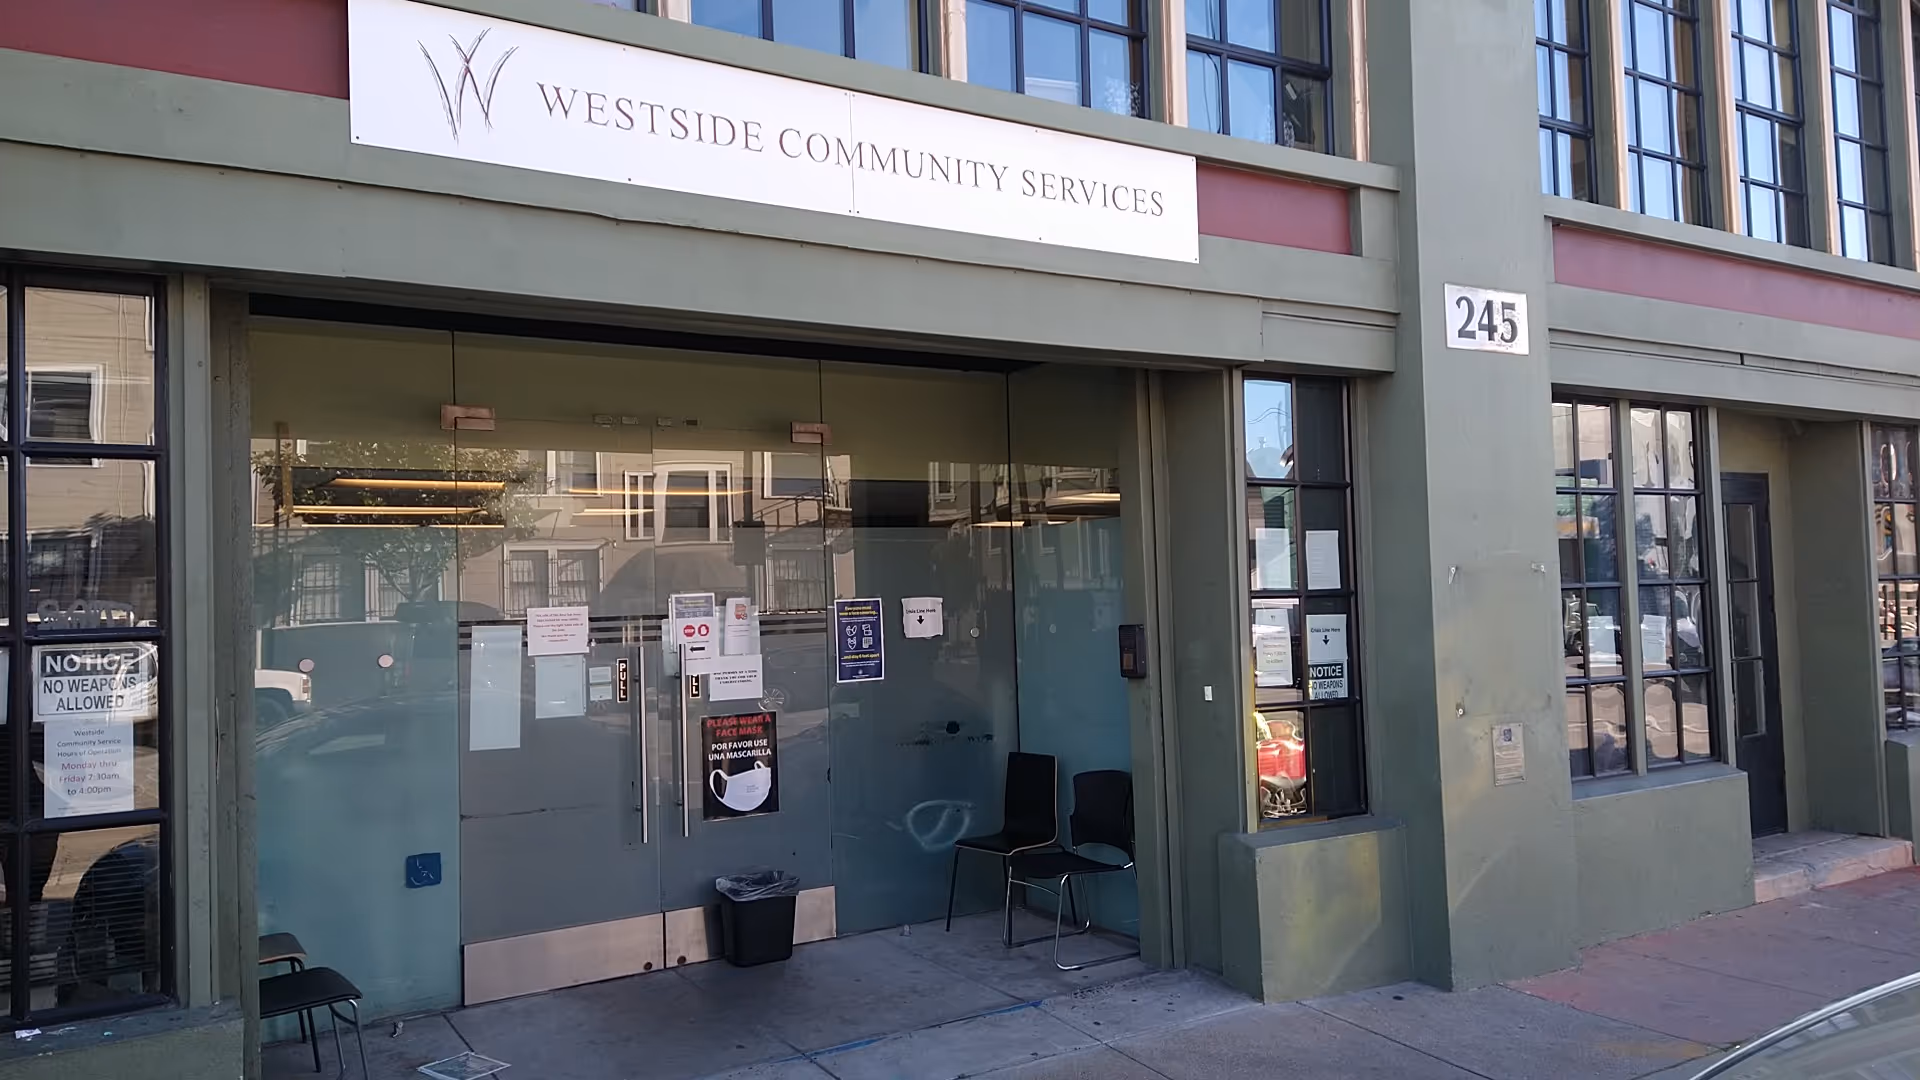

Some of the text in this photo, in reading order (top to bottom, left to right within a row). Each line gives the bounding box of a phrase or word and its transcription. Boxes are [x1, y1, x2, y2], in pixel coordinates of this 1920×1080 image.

[536, 81, 1164, 217] WESTSIDE COMMUNITY SERVICES
[1456, 295, 1518, 343] 245
[45, 652, 135, 673] NOTICE
[1310, 665, 1342, 678] NOTICE
[44, 677, 137, 694] NO WEAPONS
[1318, 680, 1344, 689] WEAPONS
[56, 695, 125, 712] ALLOWED
[707, 714, 771, 728] PLEASE WEAR A
[73, 729, 105, 737] Westside
[716, 726, 763, 736] FACE MASK
[57, 740, 97, 749] Community
[712, 739, 768, 751] POR FAVOR USE
[708, 749, 771, 761] UNA MASCARILLA
[61, 760, 117, 771] Monday thru
[59, 773, 120, 783] Friday 7:30am
[67, 786, 112, 796] to 4:00pm
